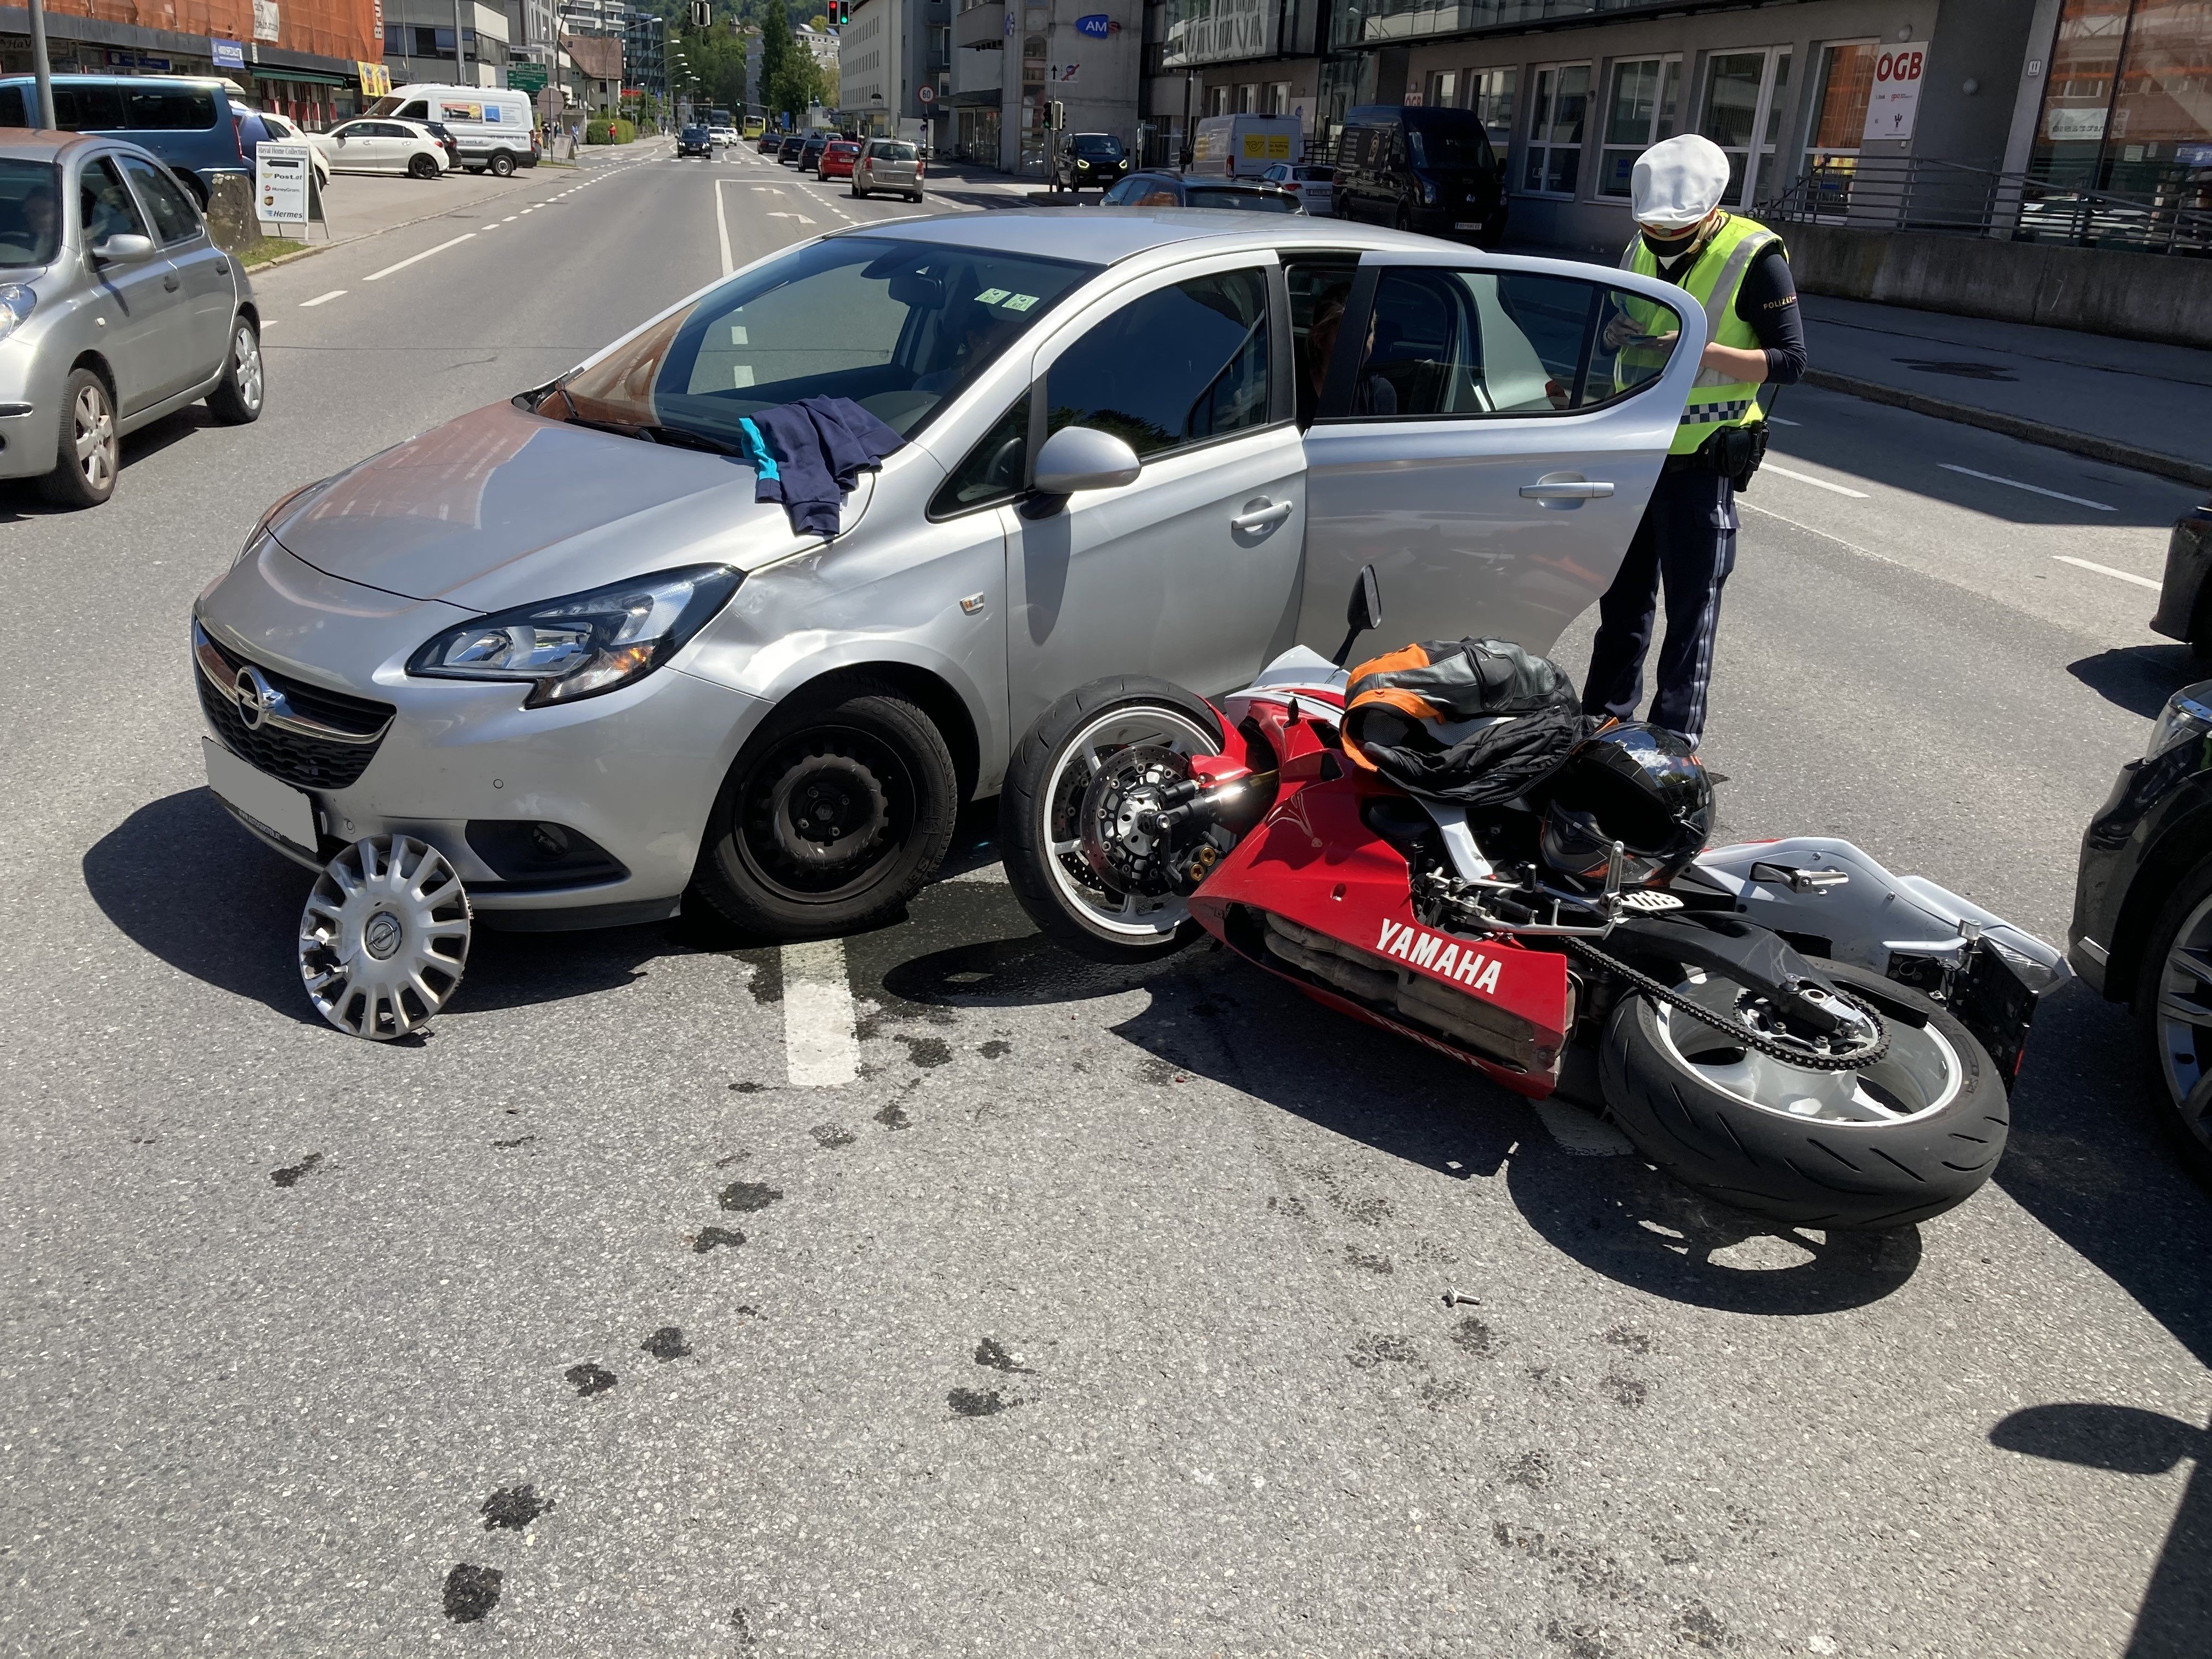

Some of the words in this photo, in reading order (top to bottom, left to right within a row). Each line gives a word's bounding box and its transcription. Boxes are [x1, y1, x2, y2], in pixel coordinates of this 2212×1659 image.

[922, 89, 930, 99] 60
[273, 210, 303, 218] Hermes
[1763, 296, 1792, 311] POLIZEI
[1376, 918, 1502, 995] YAMAHA
